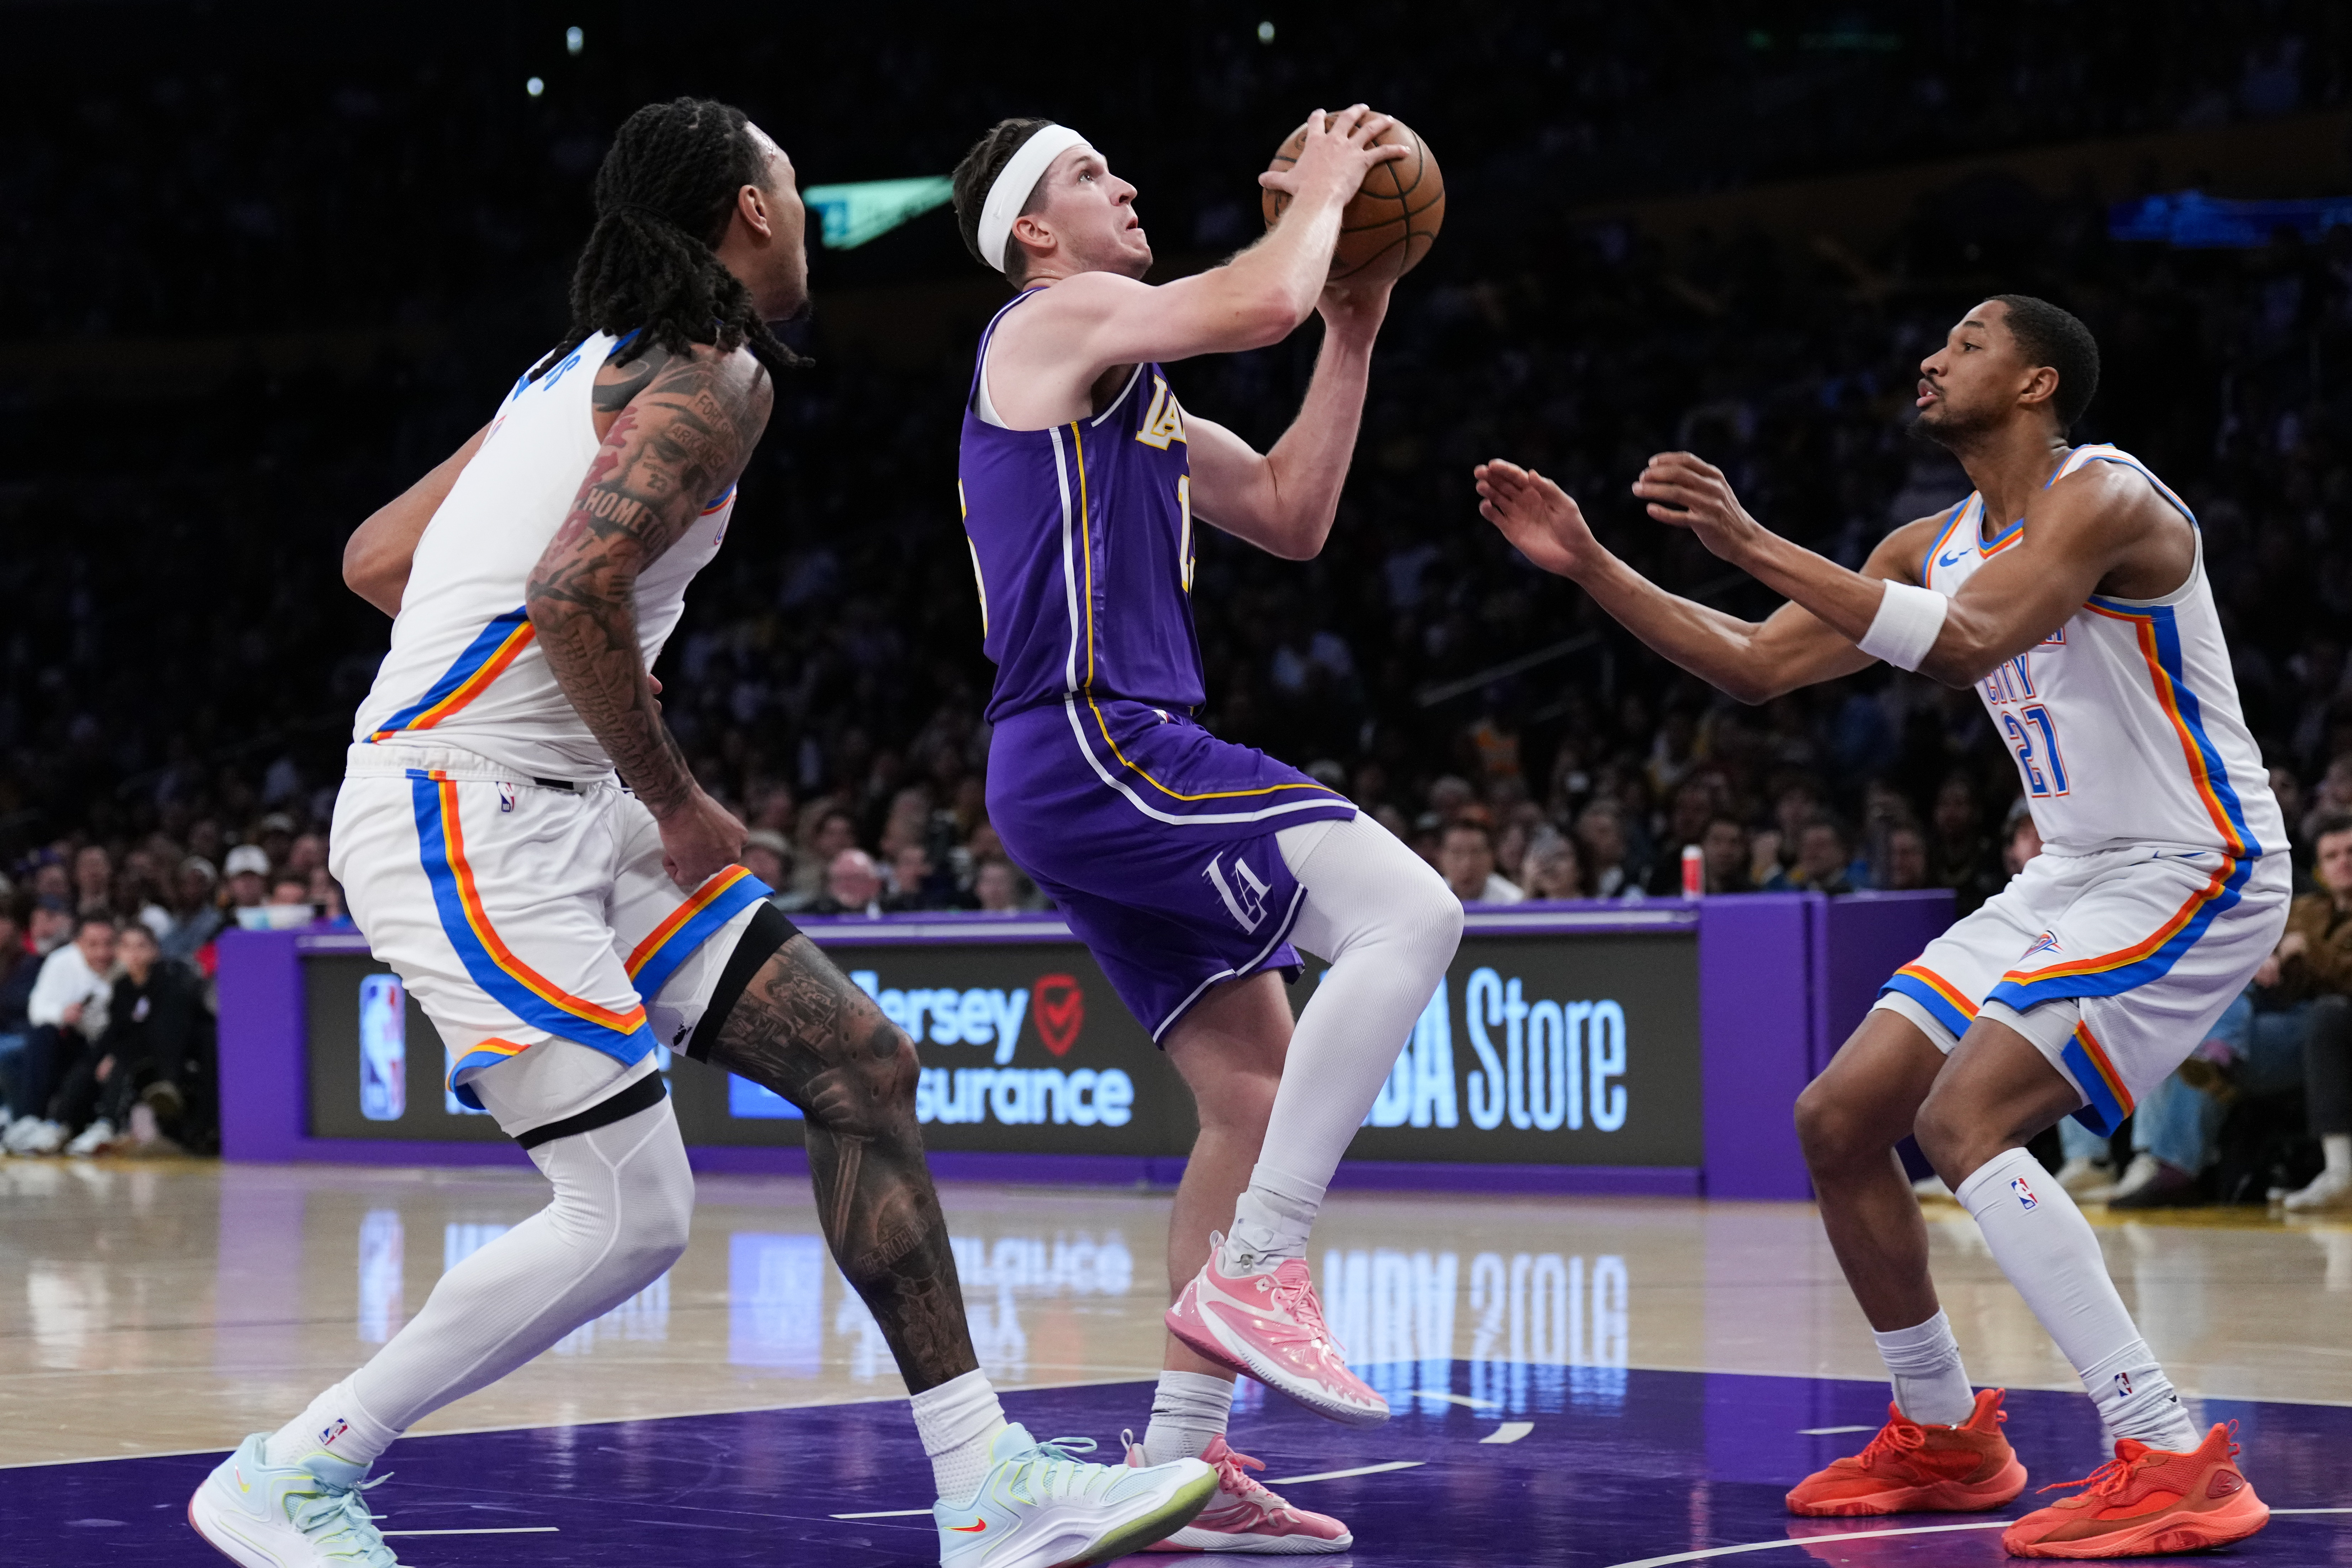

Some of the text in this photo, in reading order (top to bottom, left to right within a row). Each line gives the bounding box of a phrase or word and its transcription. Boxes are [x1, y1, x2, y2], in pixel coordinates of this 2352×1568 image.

[1135, 374, 1187, 450] LA
[1178, 474, 1195, 599] 1
[1983, 652, 2036, 705] CITY
[1202, 851, 1272, 936] LA
[1466, 967, 1627, 1132] Store
[915, 1067, 1135, 1127] surance
